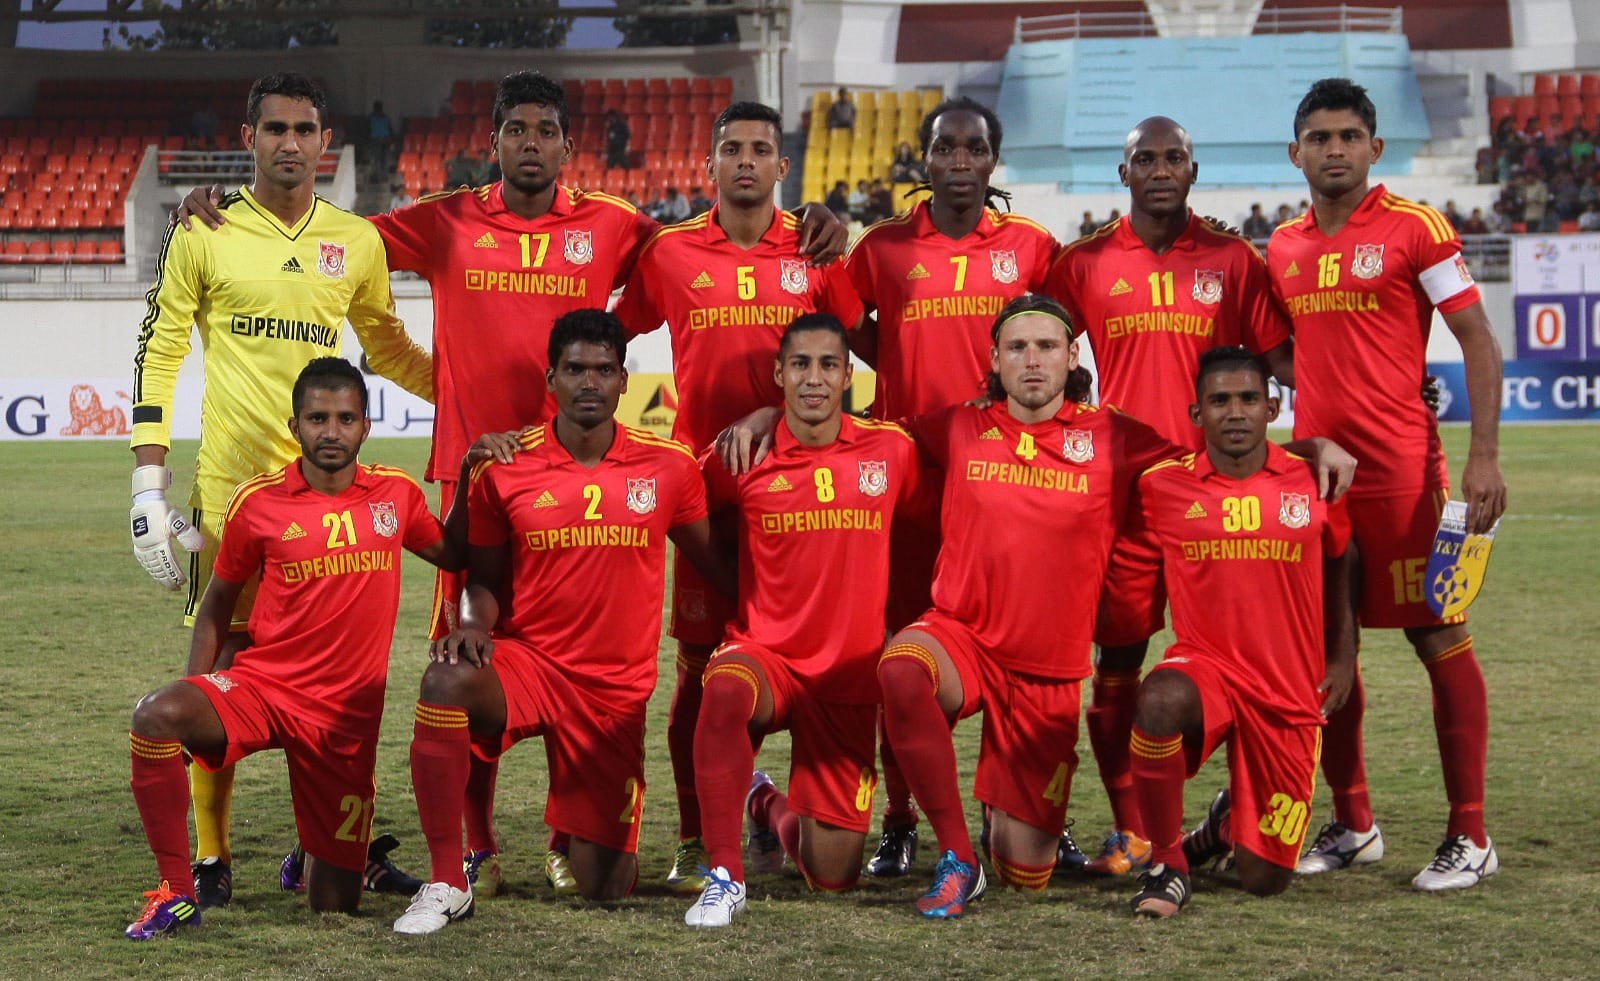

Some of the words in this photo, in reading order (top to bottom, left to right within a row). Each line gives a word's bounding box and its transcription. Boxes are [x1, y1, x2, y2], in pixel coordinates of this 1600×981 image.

[518, 233, 550, 268] 17
[486, 271, 586, 297] PENINSULA
[736, 265, 756, 300] 5
[950, 255, 968, 291] 7
[1318, 252, 1342, 289] 15
[1148, 271, 1174, 306] 11
[1294, 290, 1379, 316] PENINSULA
[921, 296, 1006, 319] PENINSUL
[1124, 311, 1214, 336] PENINSULA
[254, 317, 338, 349] PENINSULA
[1536, 308, 1560, 346] 0
[1502, 376, 1541, 410] FC
[1015, 431, 1038, 460] 4
[814, 467, 835, 503] 8
[987, 462, 1089, 494] PENINSULA
[583, 484, 603, 520] 2
[1222, 495, 1261, 533] 30
[322, 510, 357, 549] 21
[548, 525, 649, 549] PENINSULA
[783, 508, 882, 532] PENINSULA
[300, 550, 393, 580] PENINSULA
[1200, 538, 1302, 562] PENINSULA
[1435, 539, 1462, 556] T&T
[1389, 557, 1427, 605] 15
[619, 777, 638, 823] 2
[855, 765, 872, 812] 8
[1042, 761, 1068, 807] 4
[335, 794, 372, 842] 21
[1258, 792, 1307, 845] 30
